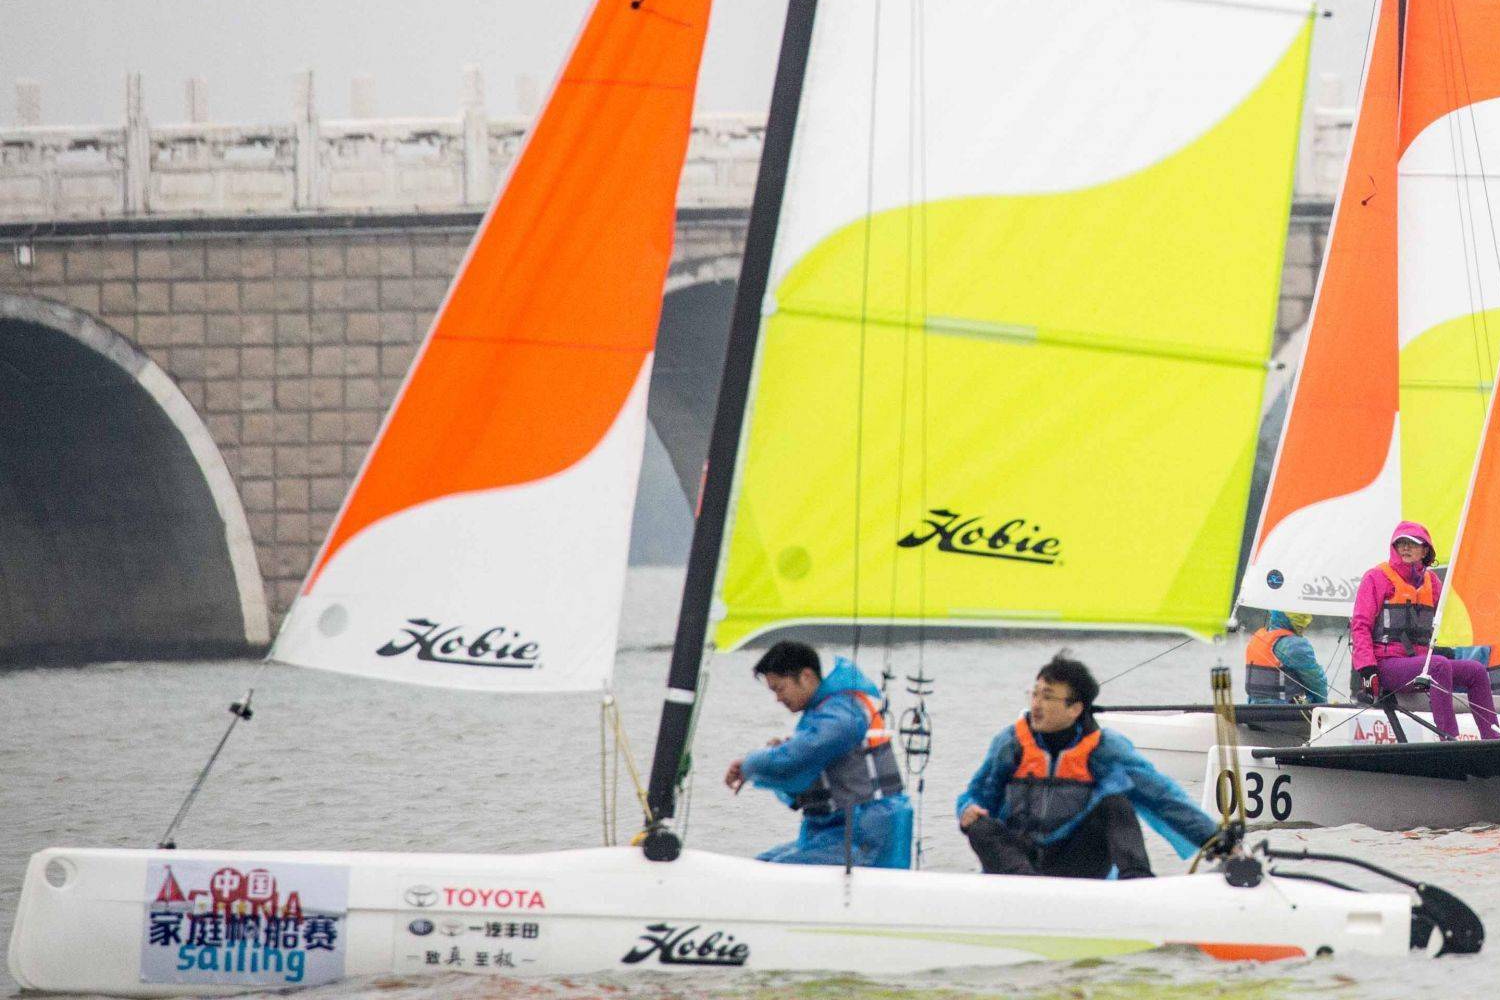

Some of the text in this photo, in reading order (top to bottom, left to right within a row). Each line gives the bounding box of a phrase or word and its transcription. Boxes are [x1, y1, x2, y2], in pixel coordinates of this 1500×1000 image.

[896, 508, 1062, 566] Hobie
[375, 618, 540, 670] Hobie
[1215, 769, 1293, 821] 036
[212, 868, 275, 900] 中国
[443, 887, 547, 910] TOYOTA
[149, 911, 340, 951] 家庭帆船赛
[621, 922, 751, 967] Hobie
[176, 939, 306, 983] sailing
